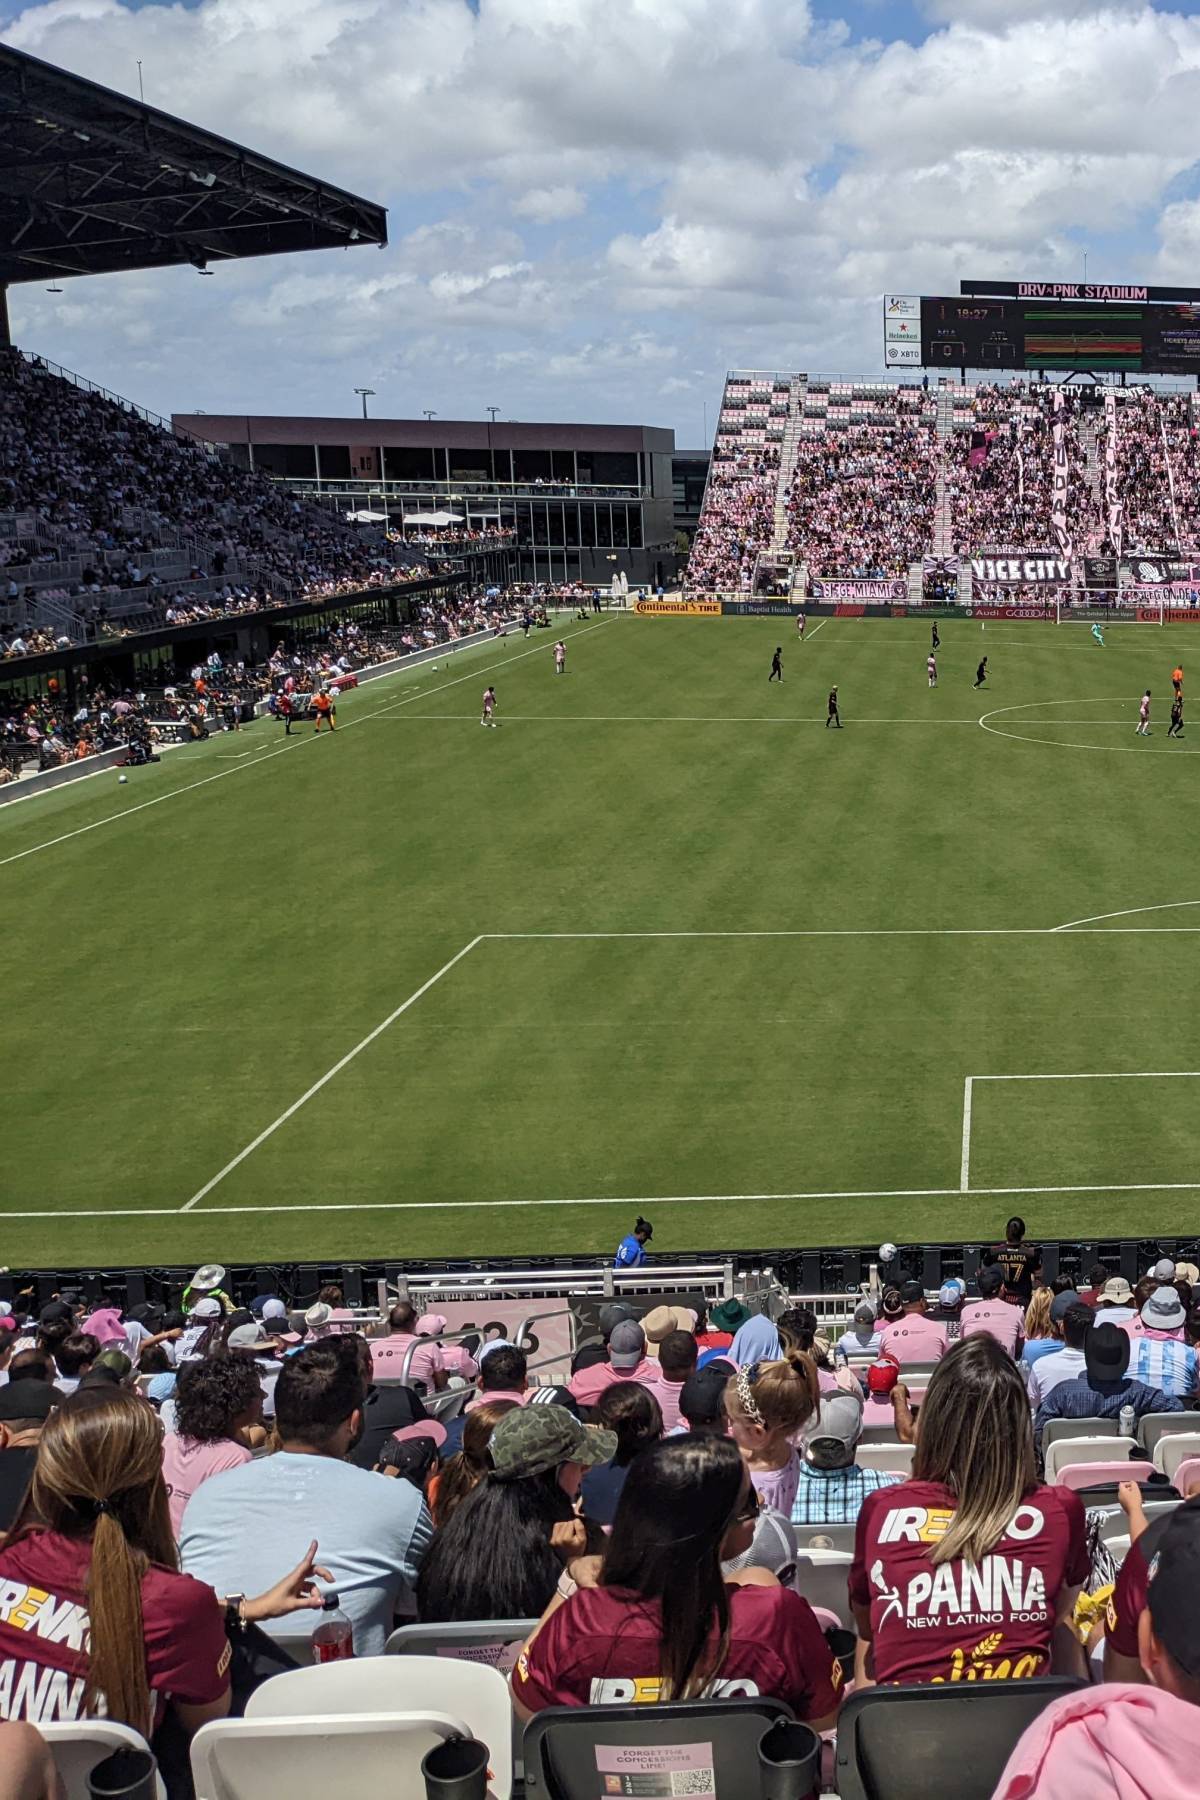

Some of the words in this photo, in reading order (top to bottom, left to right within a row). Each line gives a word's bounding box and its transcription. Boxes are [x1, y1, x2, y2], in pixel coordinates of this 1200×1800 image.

[1085, 286, 1148, 300] STADIUM
[1059, 385, 1083, 398] CITY
[972, 560, 1021, 581] VICE
[1023, 560, 1069, 581] CITY
[855, 580, 891, 598] MIAMI
[636, 602, 688, 614] Continental
[749, 605, 768, 614] Baptist
[976, 609, 999, 617] Audi
[997, 1254, 1027, 1262] ATLANTA
[1001, 1263, 1024, 1282] 17
[907, 1555, 1047, 1617] PANNA
[906, 1618, 942, 1629] NEW
[947, 1614, 1004, 1626] LATINO
[1010, 1612, 1047, 1623] FOOD
[616, 1755, 691, 1764] CONCESSIONS
